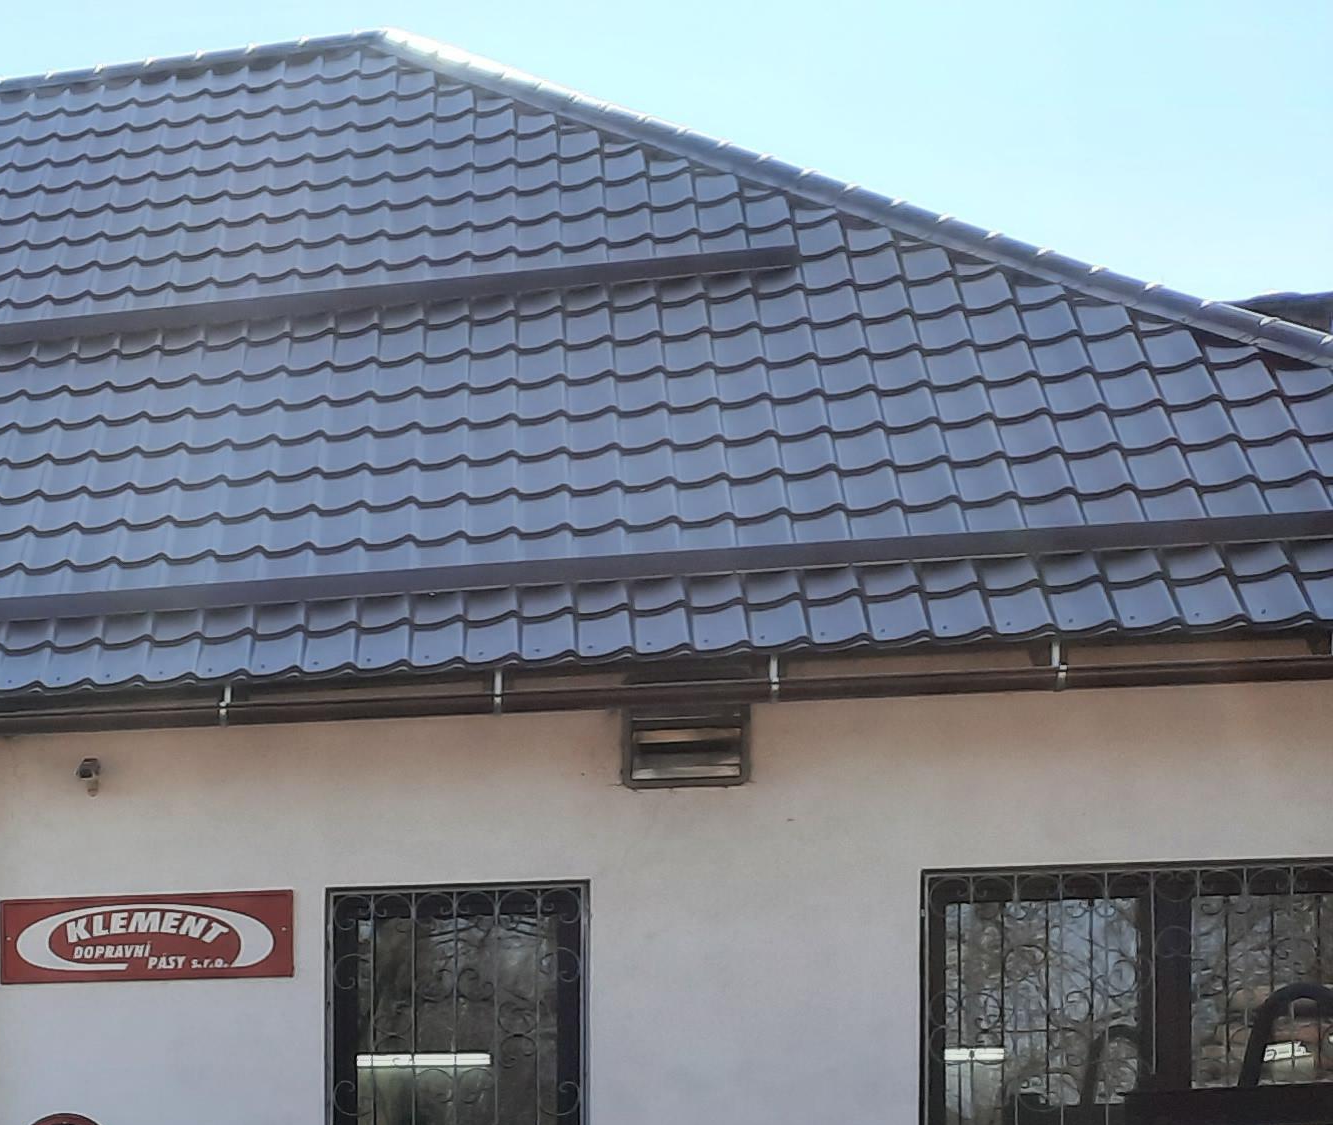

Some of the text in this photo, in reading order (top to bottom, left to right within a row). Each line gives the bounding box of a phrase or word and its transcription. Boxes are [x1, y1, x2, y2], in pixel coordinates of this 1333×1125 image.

[66, 911, 230, 944] KLEMENT
[73, 941, 152, 959] DOPRAVNÍ
[147, 953, 230, 970] PÁSY s.r.o.
